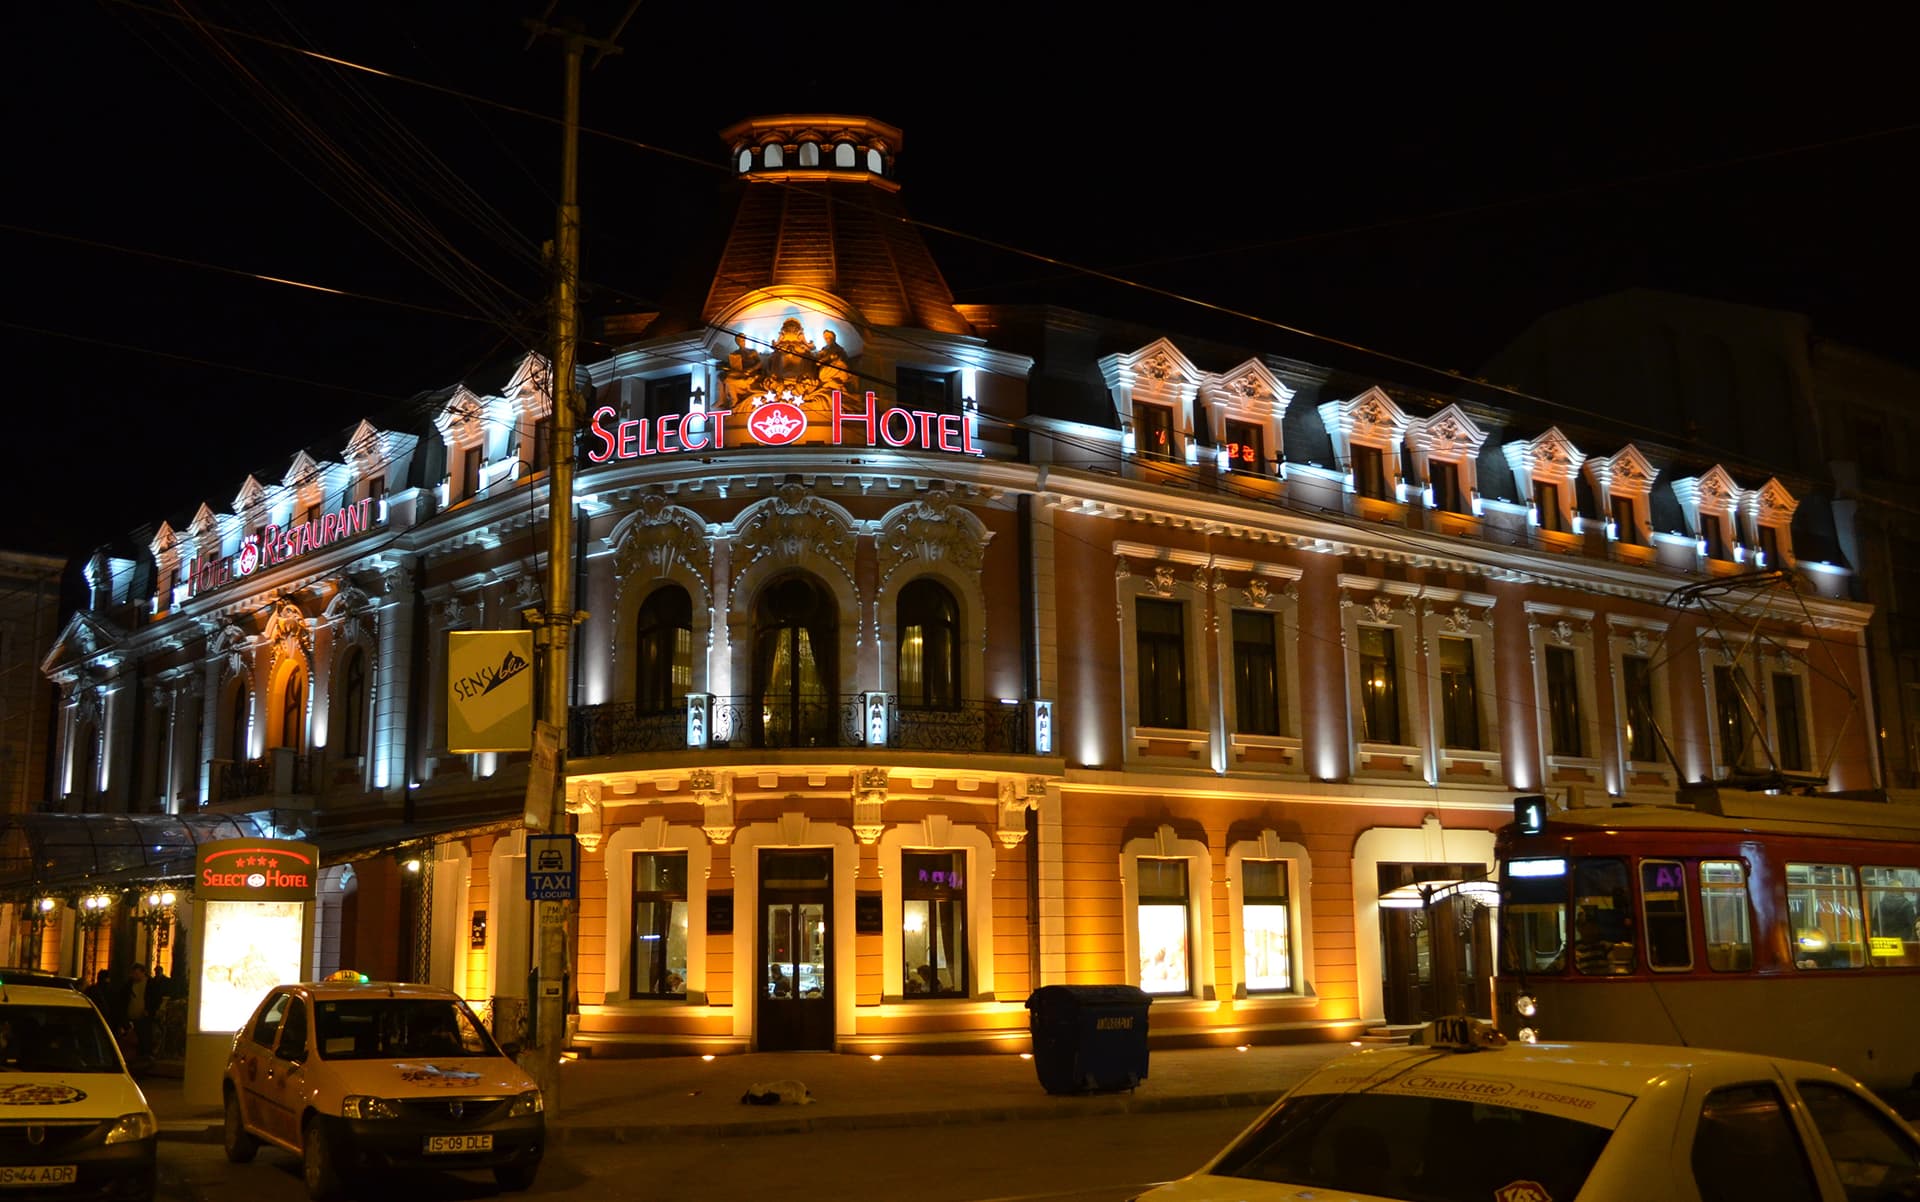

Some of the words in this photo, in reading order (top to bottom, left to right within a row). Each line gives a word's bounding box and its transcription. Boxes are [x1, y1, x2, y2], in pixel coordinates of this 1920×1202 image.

[588, 406, 733, 464] SELECT
[832, 390, 984, 456] HOTEL
[187, 554, 233, 597] HOTEL
[262, 497, 373, 567] RESTAURANT
[453, 666, 495, 702] SENSI
[1525, 805, 1540, 828] 1
[202, 868, 247, 887] SELECT
[265, 869, 309, 888] HOTEL
[531, 875, 571, 891] TAXI
[532, 891, 538, 899] 5
[540, 890, 571, 899] LOCURI
[1407, 1076, 1505, 1095] Charlotte
[432, 1136, 443, 1150] IS
[448, 1137, 463, 1149] 09
[466, 1135, 490, 1149] DLE
[0, 1167, 14, 1183] IS
[19, 1167, 36, 1182] 44
[40, 1166, 73, 1181] ADR
